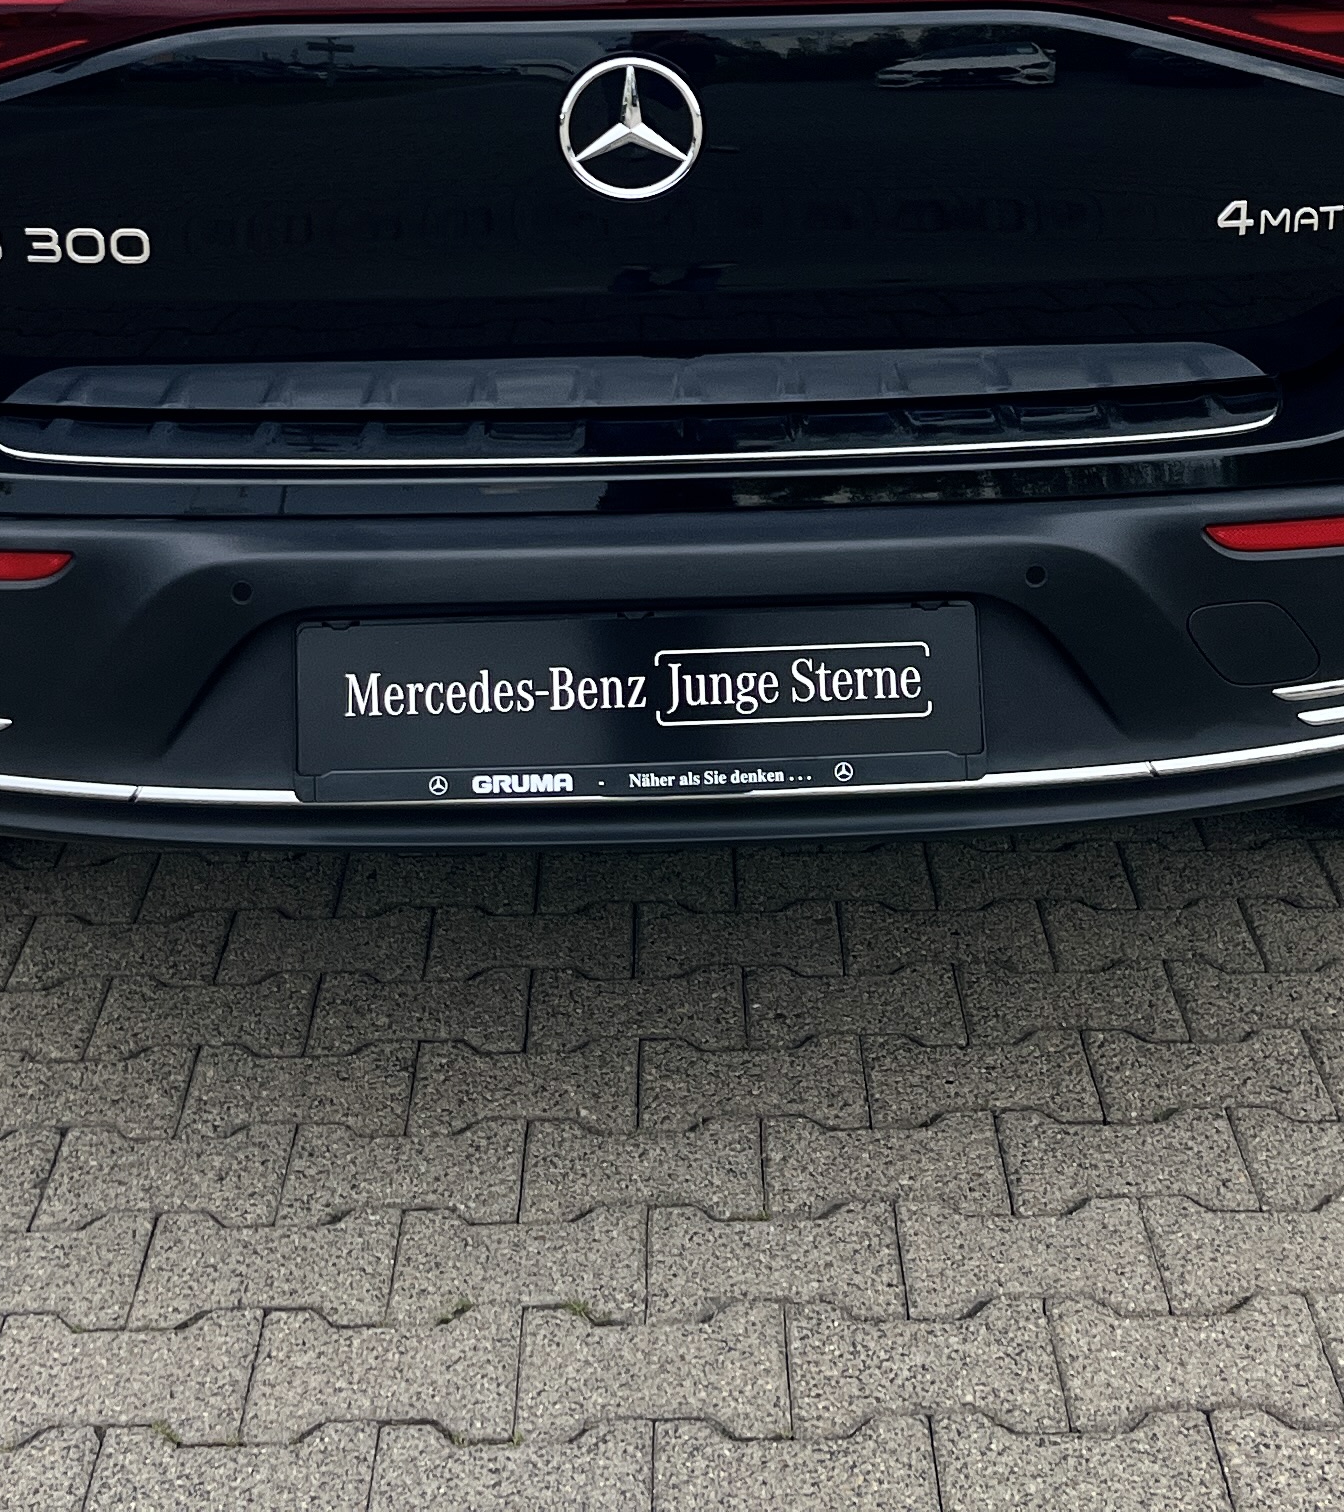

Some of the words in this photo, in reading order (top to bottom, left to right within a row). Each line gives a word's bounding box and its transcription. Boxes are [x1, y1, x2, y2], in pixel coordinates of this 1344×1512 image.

[24, 227, 151, 265] 300
[344, 666, 647, 718] Mercedes-Benz
[666, 662, 780, 715] Junge
[791, 657, 922, 703] Sterne
[471, 773, 574, 794] GRUMA
[628, 772, 676, 788] Näher
[678, 771, 701, 786] als
[703, 770, 728, 785] Sie
[730, 768, 785, 784] denken
